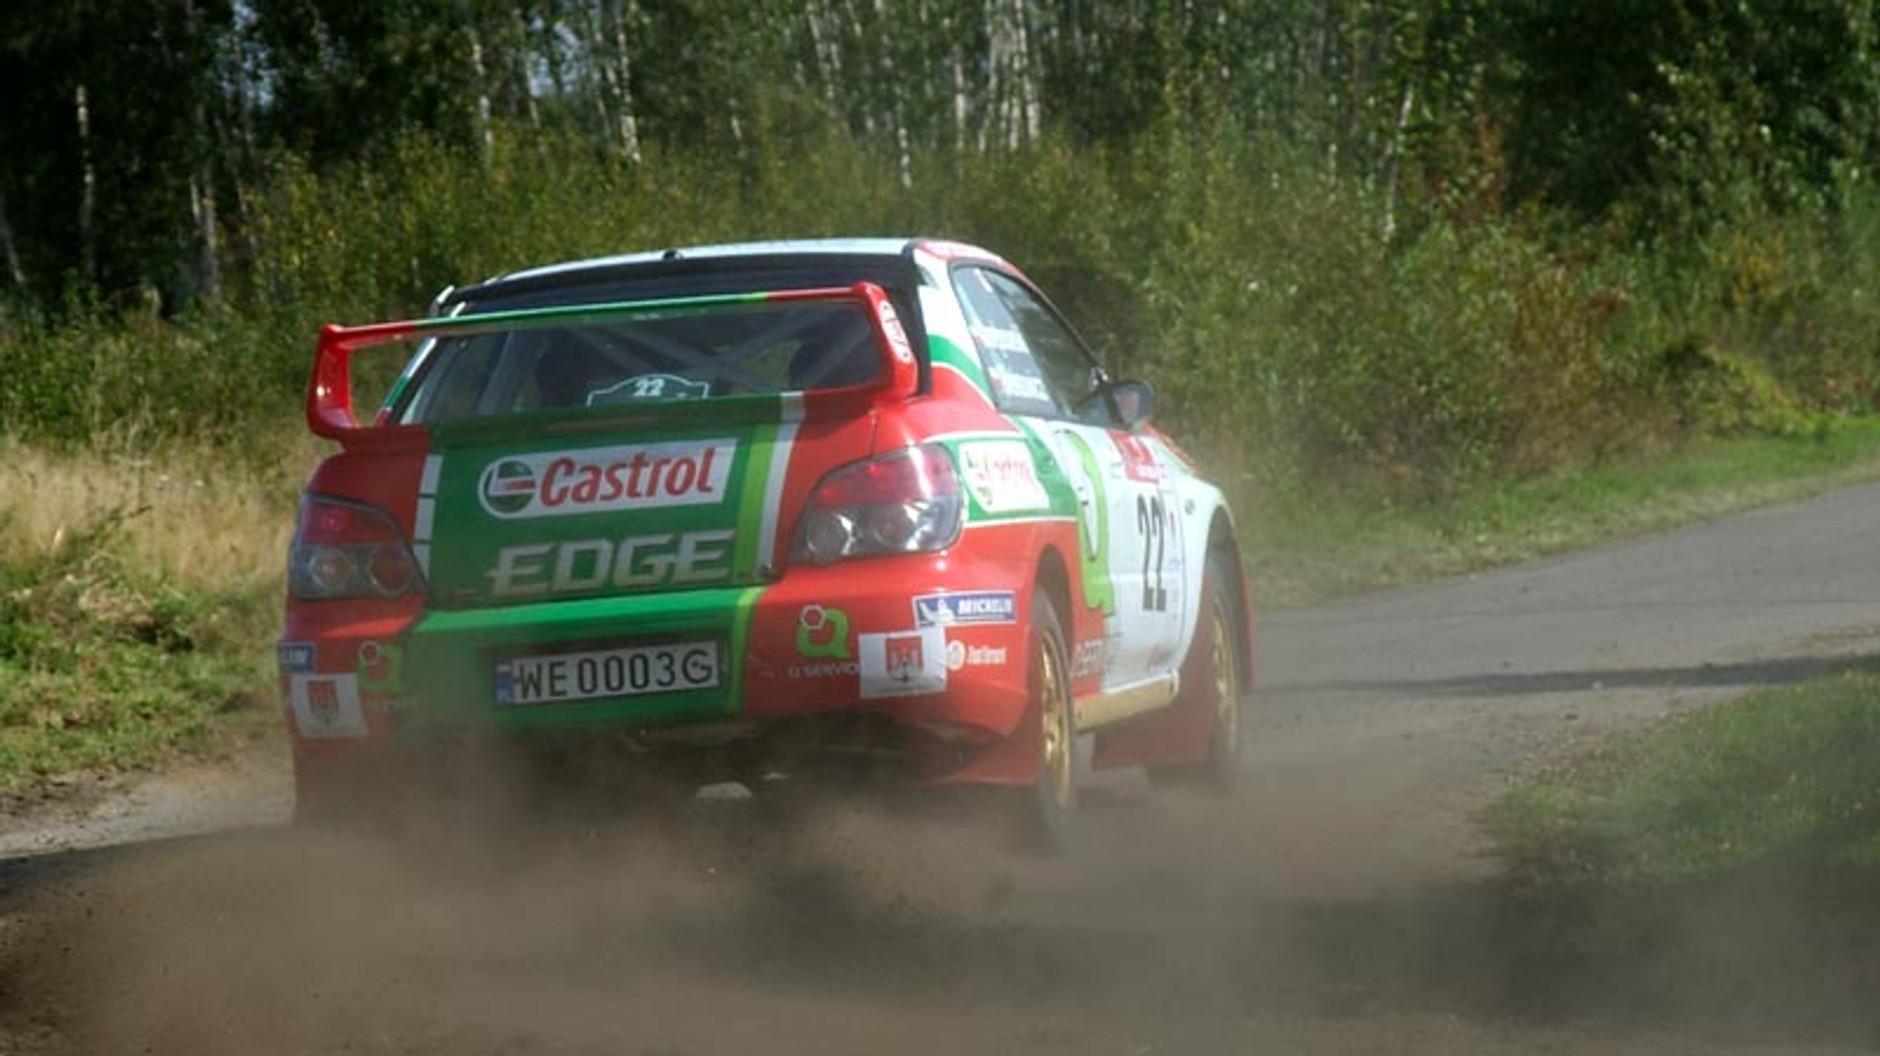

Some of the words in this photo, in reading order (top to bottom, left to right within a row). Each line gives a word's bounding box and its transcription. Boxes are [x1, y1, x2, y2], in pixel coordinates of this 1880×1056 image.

[633, 378, 664, 396] 22
[539, 447, 716, 507] Castrol
[486, 529, 735, 597] EDGE
[1137, 493, 1167, 612] 22
